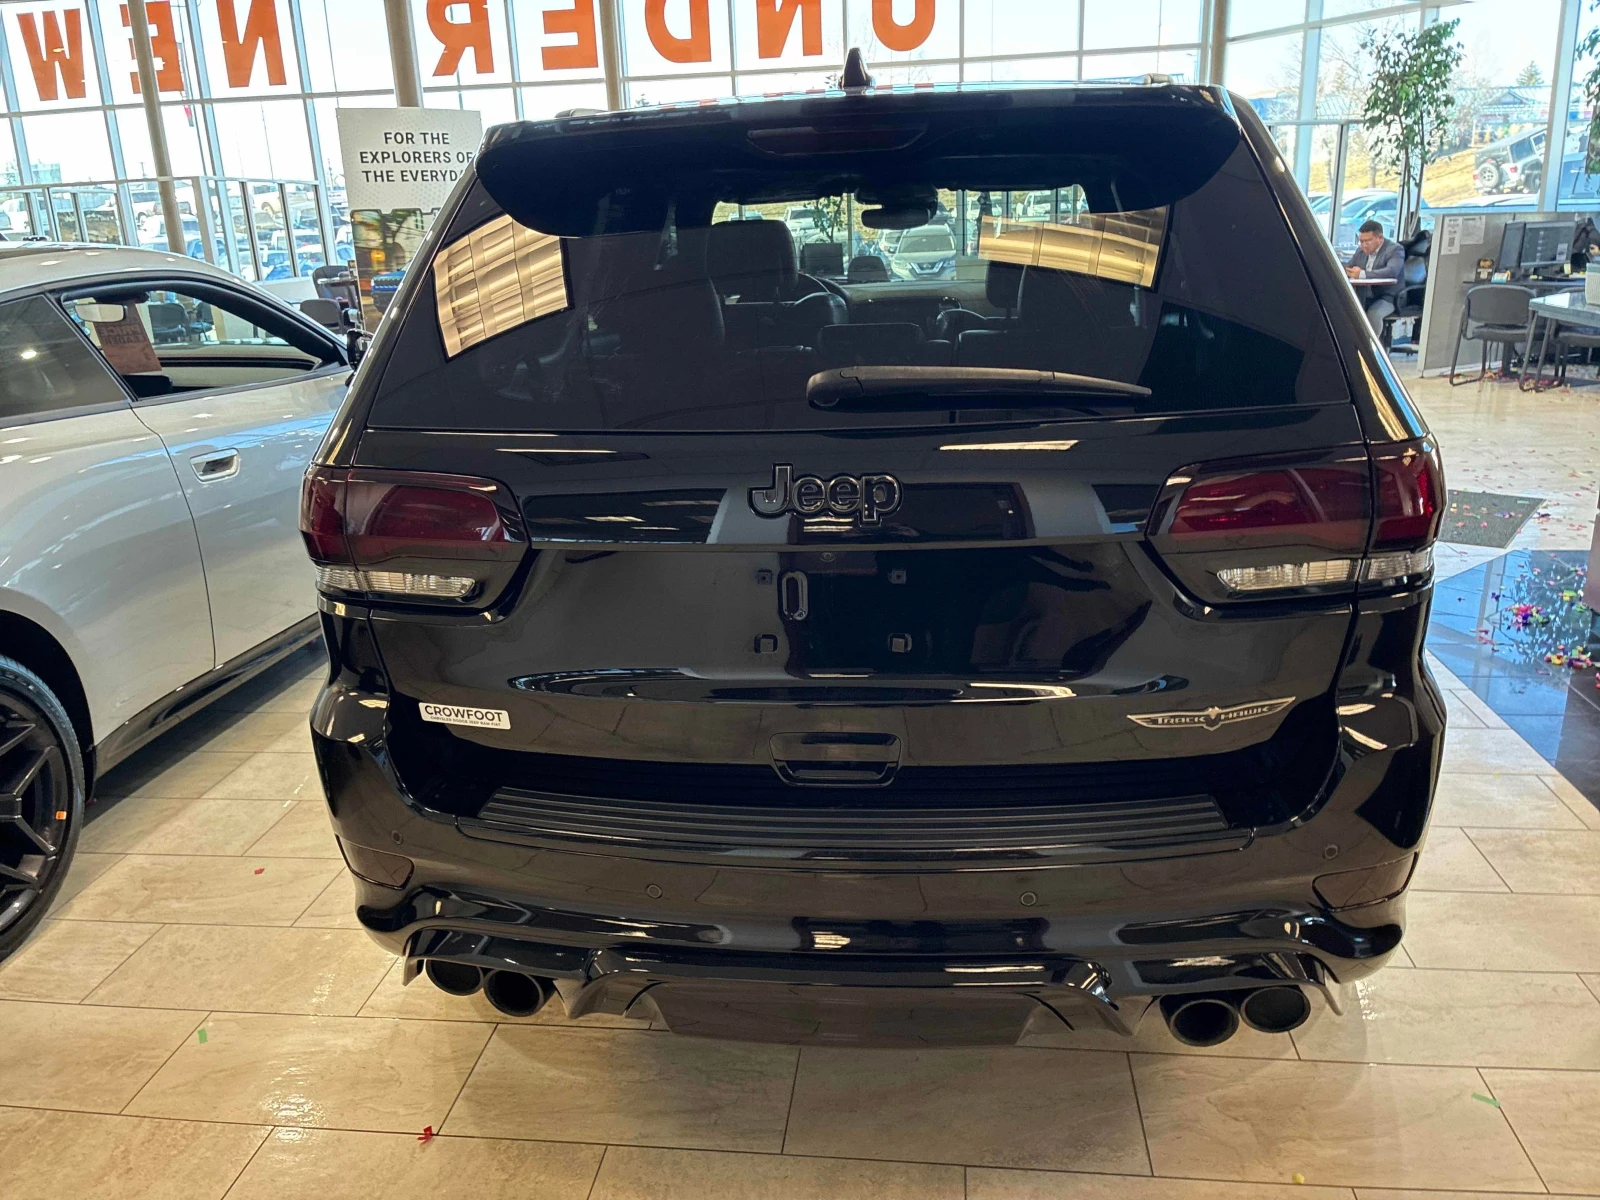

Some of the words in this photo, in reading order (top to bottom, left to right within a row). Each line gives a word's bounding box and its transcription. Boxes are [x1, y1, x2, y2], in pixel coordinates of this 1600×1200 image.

[383, 131, 415, 145] FOR
[420, 132, 450, 145] THE
[359, 151, 452, 164] EXPLORERS
[456, 152, 474, 163] OF
[361, 170, 396, 183] THE
[400, 170, 463, 182] EVERYD
[747, 462, 904, 528] Jeep
[424, 705, 503, 722] CROWFOOT
